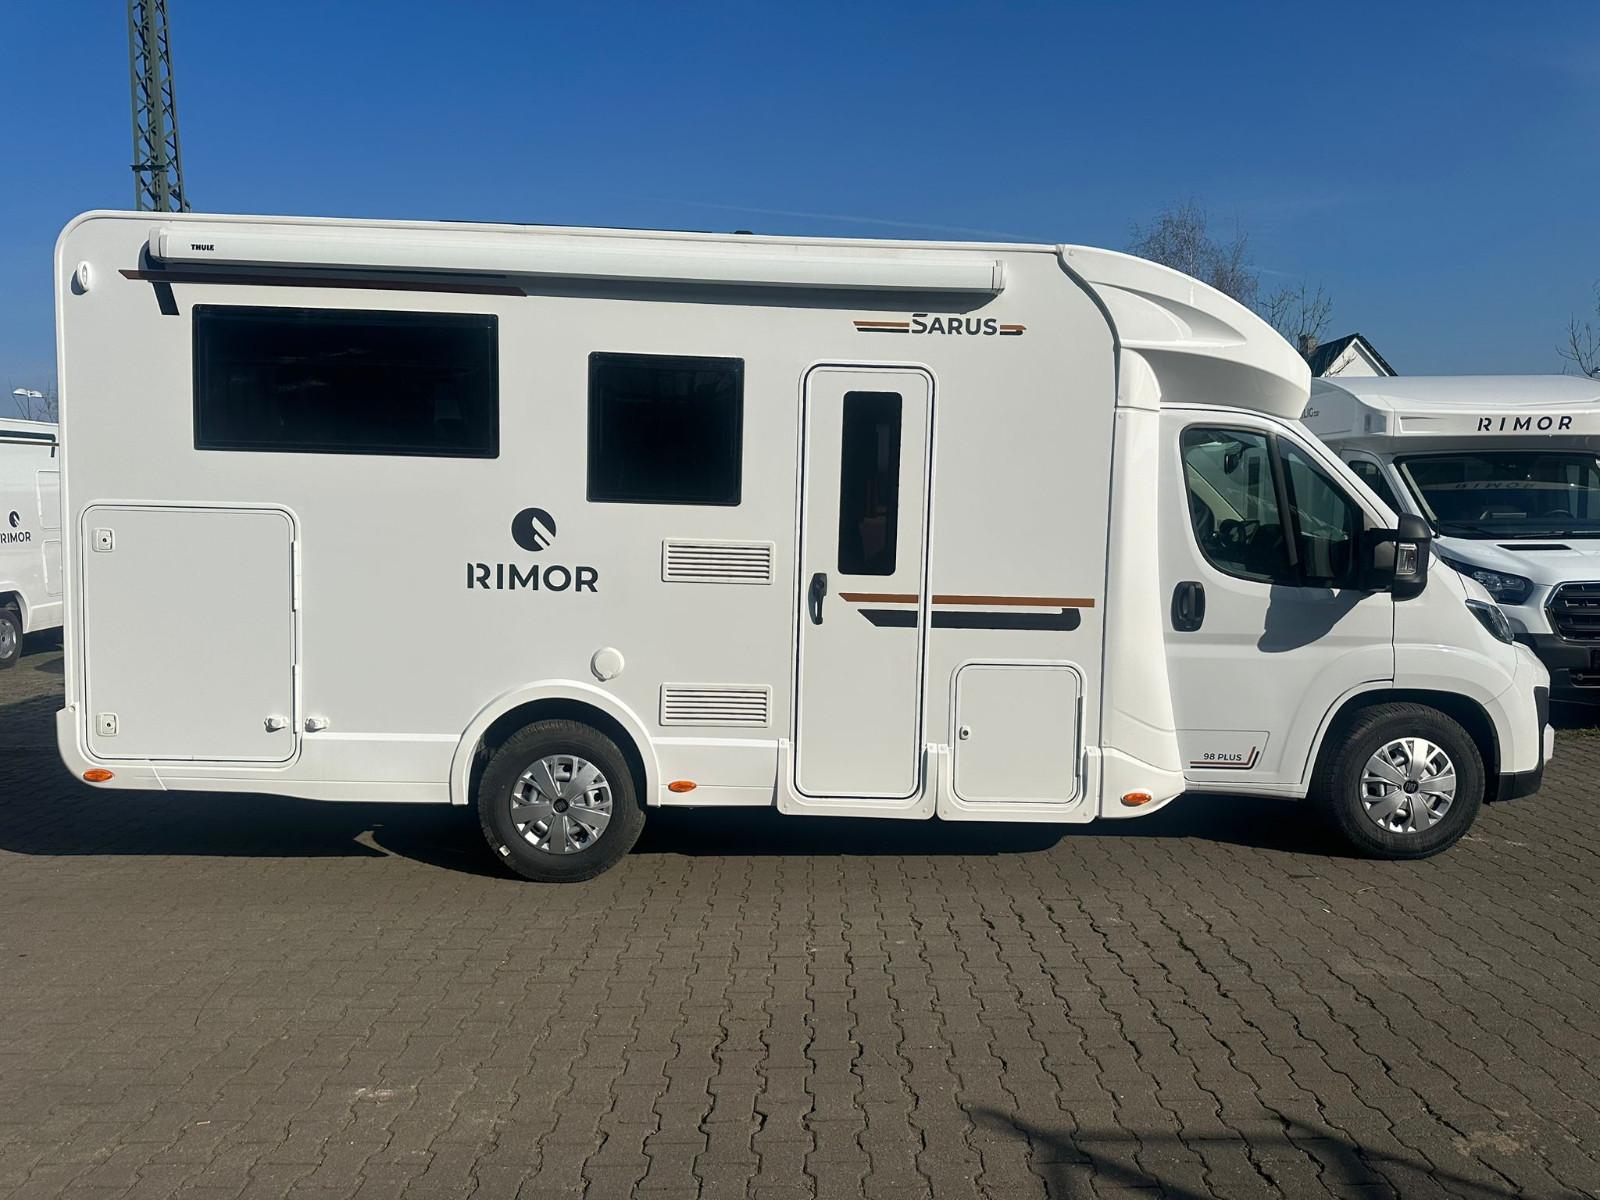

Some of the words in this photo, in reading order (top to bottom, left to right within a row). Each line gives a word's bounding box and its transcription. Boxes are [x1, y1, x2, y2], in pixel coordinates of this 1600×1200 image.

[911, 313, 998, 335] SARUS
[1477, 415, 1573, 431] RIMOR
[0, 531, 31, 543] RIMOR
[467, 562, 599, 593] RIMOR
[1203, 752, 1215, 760] 98
[1217, 753, 1242, 761] PLUS
